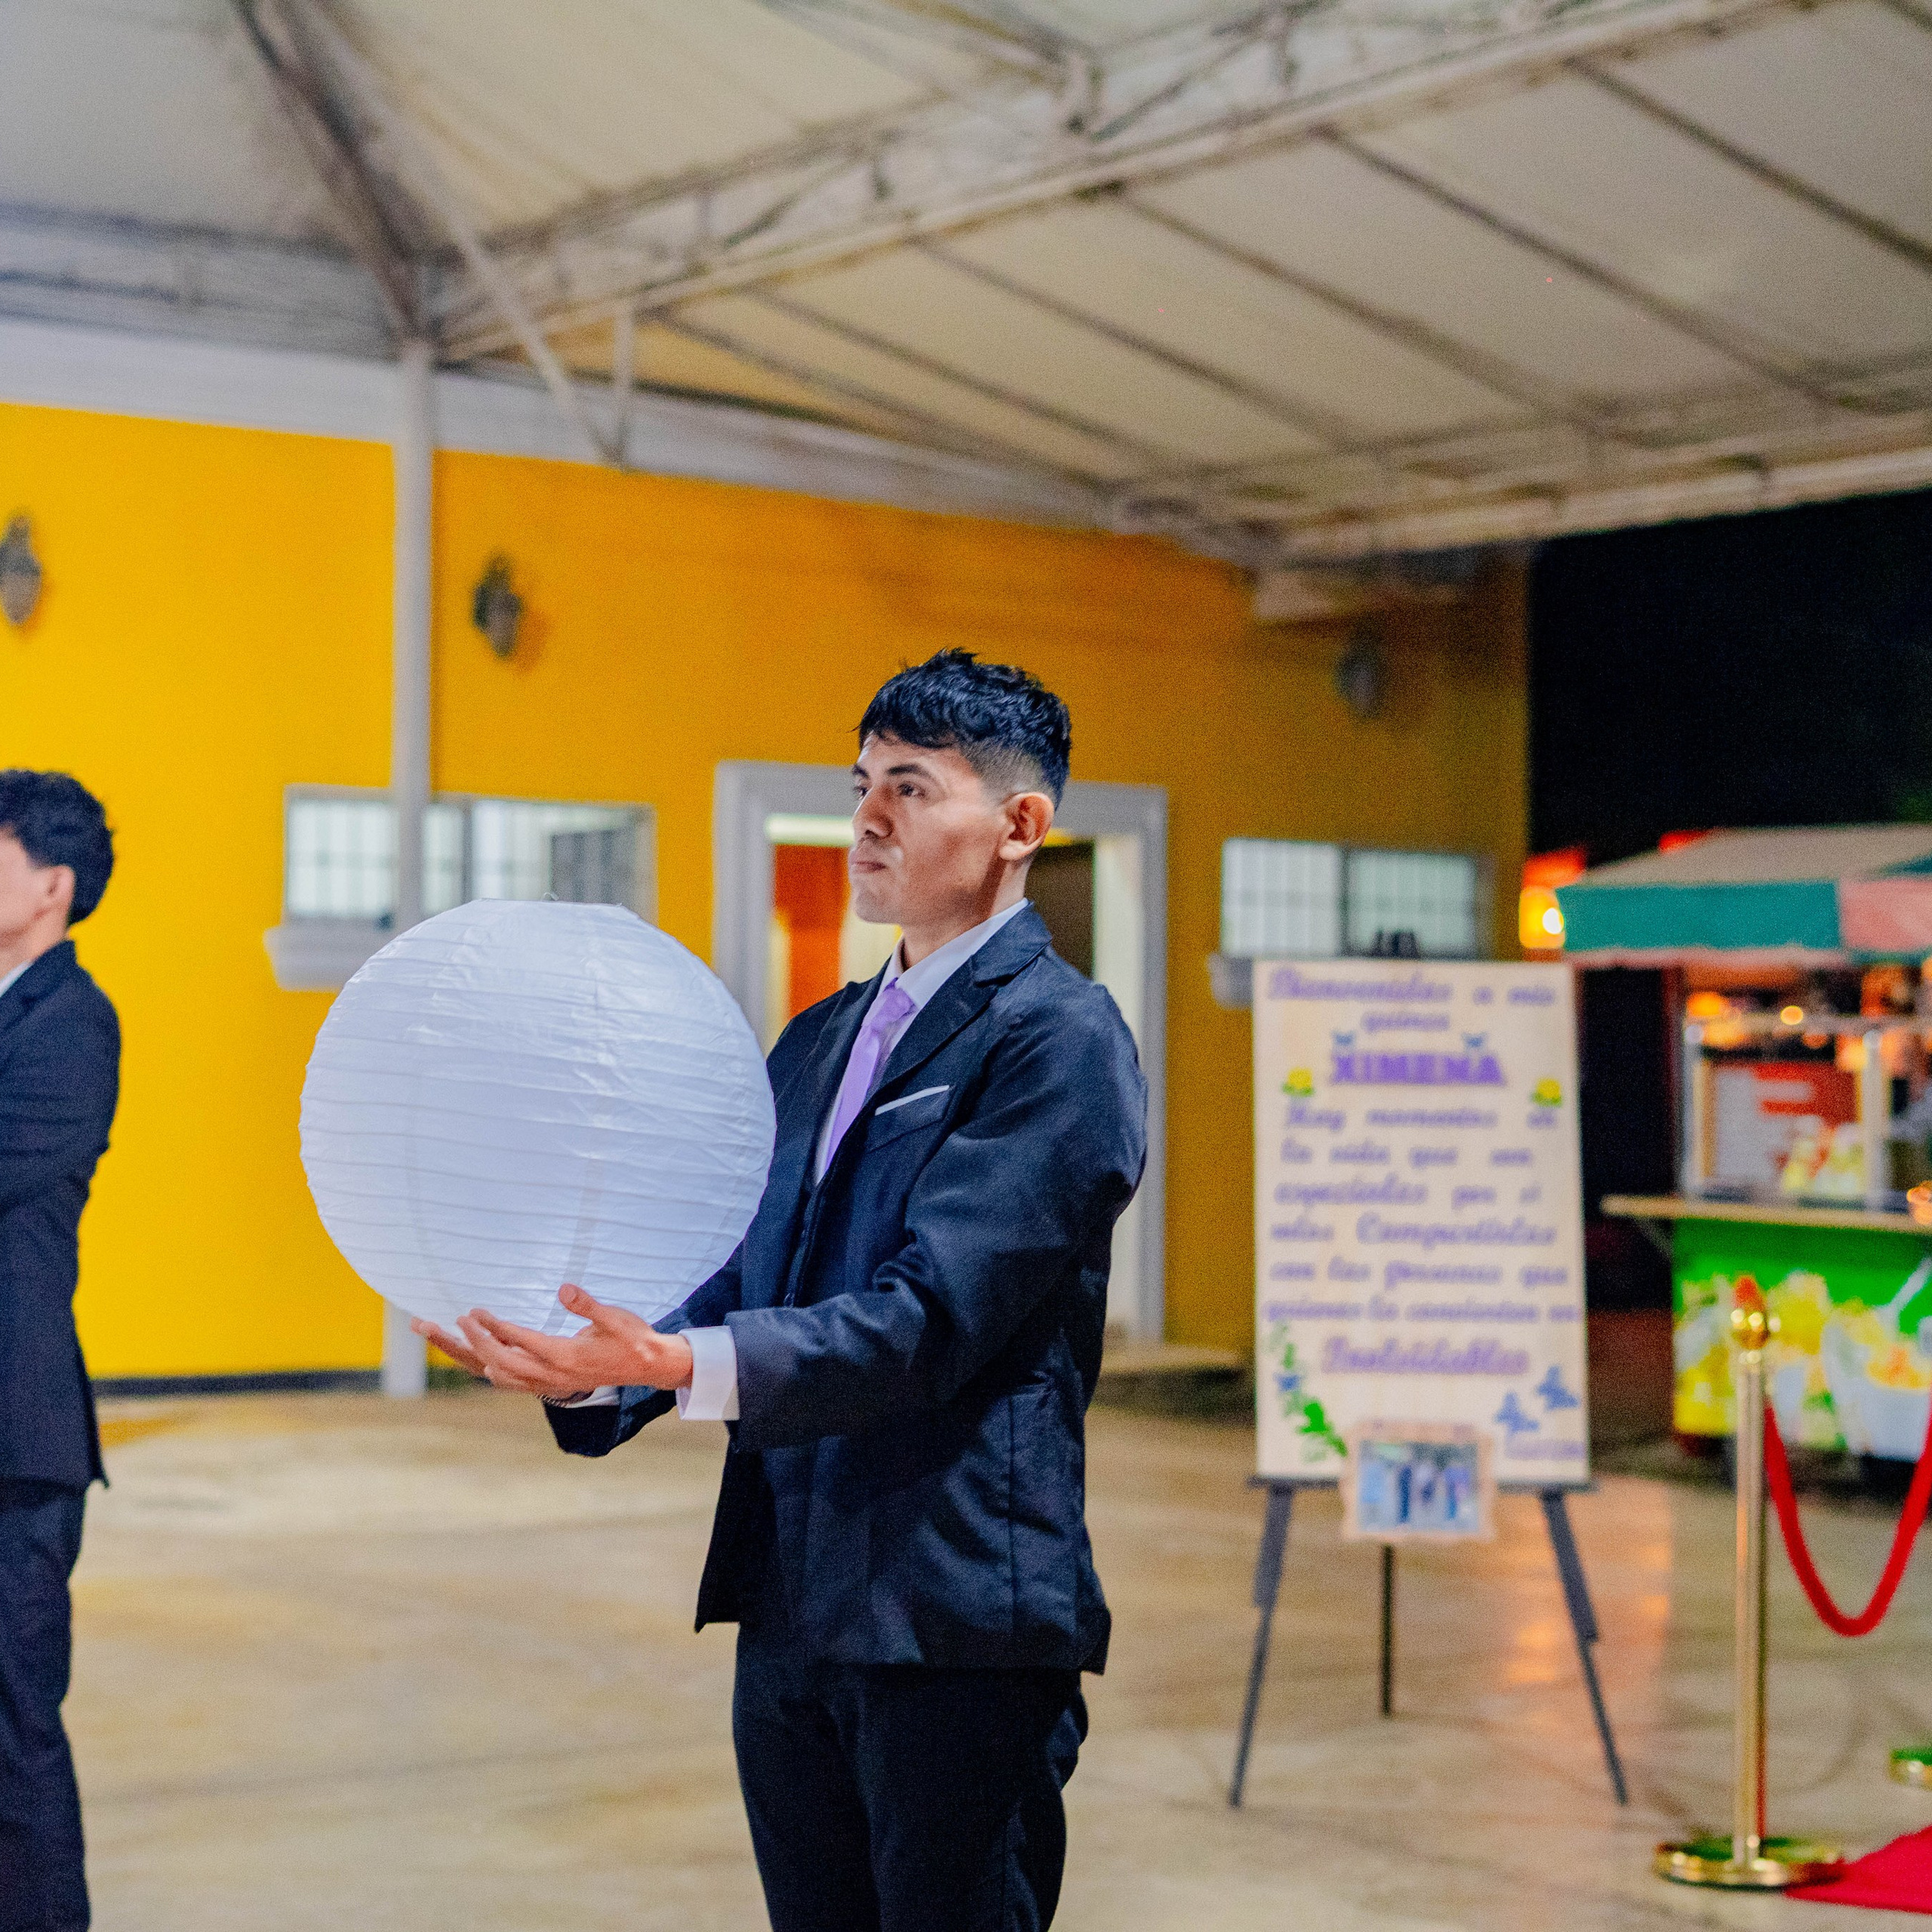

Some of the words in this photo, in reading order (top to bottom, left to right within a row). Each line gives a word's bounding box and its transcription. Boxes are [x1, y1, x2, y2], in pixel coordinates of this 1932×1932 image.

[1331, 1053, 1506, 1085] XIMENA
[1284, 1105, 1345, 1130] Hay
[1366, 1108, 1497, 1127] momentos
[1330, 1139, 1390, 1162] vida
[1409, 1147, 1458, 1168] que
[1274, 1173, 1427, 1207] especiales
